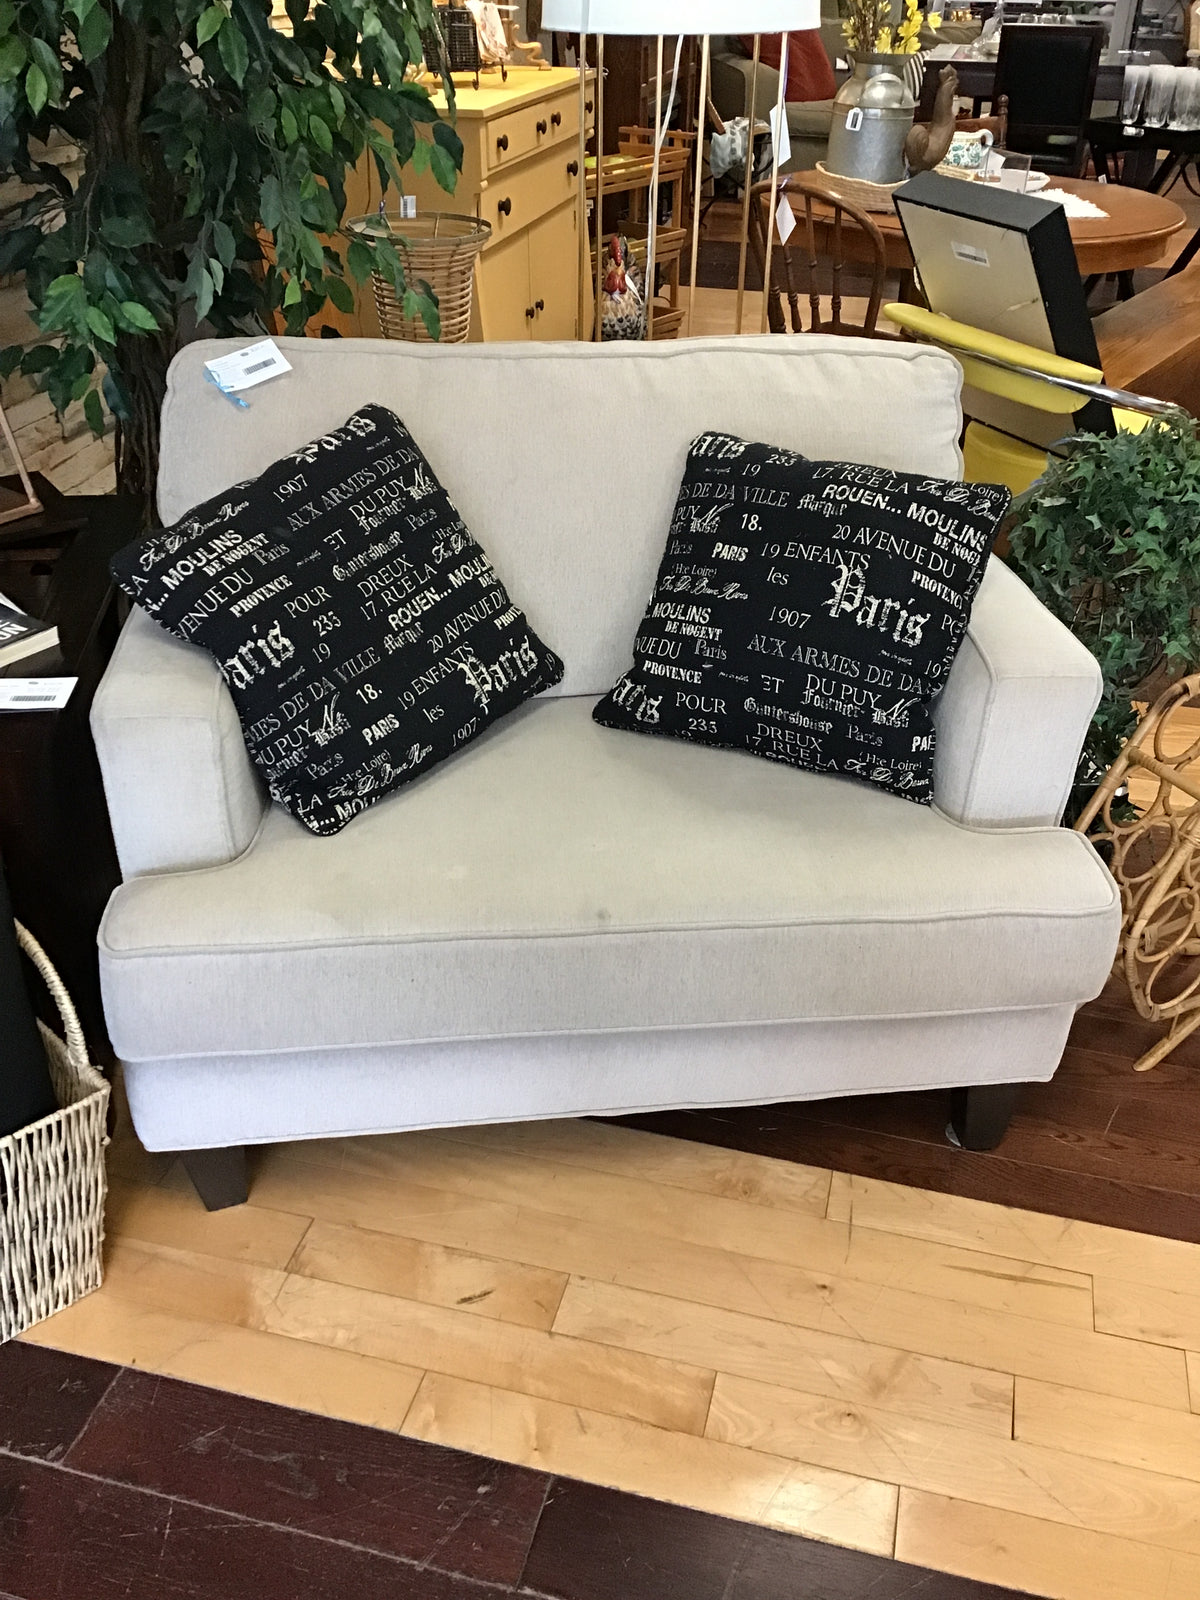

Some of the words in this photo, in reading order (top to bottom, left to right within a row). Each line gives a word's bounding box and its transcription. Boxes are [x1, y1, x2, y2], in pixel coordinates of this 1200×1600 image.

[742, 463, 761, 477] 19
[766, 454, 797, 467] 235
[273, 474, 309, 503] 1907
[287, 501, 324, 532] AUX
[321, 467, 377, 511] ARMES
[372, 454, 401, 477] DE
[692, 483, 712, 498] DE
[713, 484, 735, 499] DA
[742, 486, 790, 508] VILLE
[839, 470, 879, 488] RUE
[884, 478, 909, 494] LA
[348, 495, 376, 521] DU
[373, 475, 411, 505] PUY
[404, 507, 438, 532] Paris
[676, 505, 701, 521] PUY
[741, 514, 762, 531] 18.
[907, 502, 988, 552] MOULINS
[160, 529, 243, 590] MOULINS
[224, 532, 270, 565] NOGENT
[252, 543, 290, 566] Paris
[712, 542, 748, 561] PARIS
[761, 543, 780, 558] 19
[784, 542, 870, 571] ENFANTS
[832, 524, 851, 540] 20
[853, 527, 928, 566] AVENUE
[927, 552, 956, 578] DU
[219, 567, 254, 595] DU
[357, 554, 415, 599] DREUX
[767, 566, 790, 585] les
[229, 574, 294, 618] PROVENCE
[284, 585, 332, 619] POUR
[360, 600, 384, 621] 17.
[380, 577, 417, 607] RUE
[413, 562, 438, 585] LA
[821, 564, 931, 647] Paris
[313, 611, 341, 637] 235
[426, 634, 444, 654] 20
[445, 600, 494, 645] AVENUE
[490, 587, 508, 610] DU
[652, 602, 711, 624] MOULINS
[769, 606, 811, 629] 1907
[679, 623, 722, 641] NOGENT
[217, 619, 296, 690] aris
[312, 642, 331, 664] 19
[657, 639, 682, 659] DU
[694, 639, 727, 660] Paris
[747, 634, 787, 658] AUX
[790, 645, 860, 678] ARMES
[865, 665, 894, 688] DE
[398, 692, 416, 711] 19
[411, 641, 474, 695] ENFANTS
[457, 634, 538, 703] Paris
[643, 660, 702, 684] PROVENCE
[924, 660, 942, 679] 19
[279, 691, 310, 722] DE
[306, 675, 337, 702] DA
[333, 646, 381, 684] VILLE
[355, 682, 383, 705] 18.
[805, 674, 836, 696] DU
[841, 683, 882, 709] PUY
[422, 704, 445, 724] les
[675, 692, 728, 715] POUR
[274, 718, 314, 756] PUY
[361, 713, 400, 746] PARIS
[688, 718, 718, 734] 235
[757, 723, 823, 752] DREUX
[846, 723, 883, 746] Paris
[305, 752, 345, 780] Paris
[773, 740, 811, 761] RUE
[816, 753, 840, 771] LA
